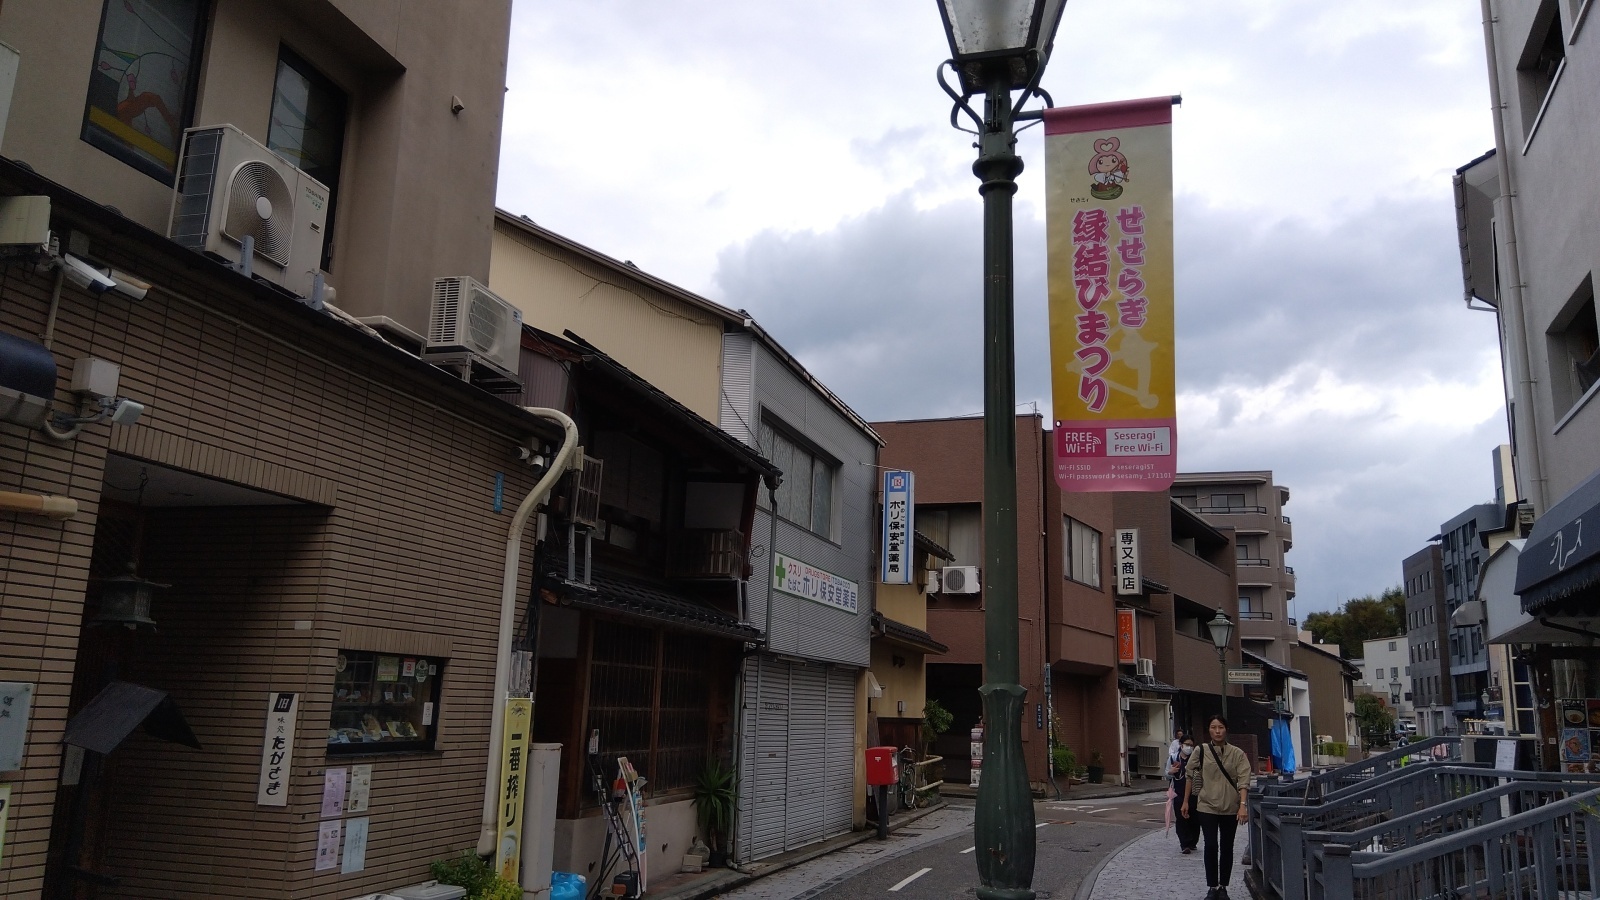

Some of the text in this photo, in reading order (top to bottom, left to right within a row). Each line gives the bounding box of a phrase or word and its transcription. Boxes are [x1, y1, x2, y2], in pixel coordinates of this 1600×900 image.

[1116, 204, 1147, 329] せせらぎ
[1072, 207, 1113, 414] 縁結びまつり
[1065, 432, 1092, 442] FREE
[1114, 430, 1156, 441] Seseragi
[1065, 443, 1096, 454] Wi-Fi
[1114, 443, 1163, 453] Free Wi-Fi
[1076, 473, 1110, 481] password
[888, 500, 901, 573] ホリ保安堂薬局
[788, 562, 801, 577] クスリ
[1120, 531, 1135, 590] 専又商店
[787, 578, 801, 592] たばこ
[802, 576, 856, 610] ホリ保安堂薬局
[265, 715, 286, 796] 味処 たかさき
[505, 733, 522, 828] 一番搾り
